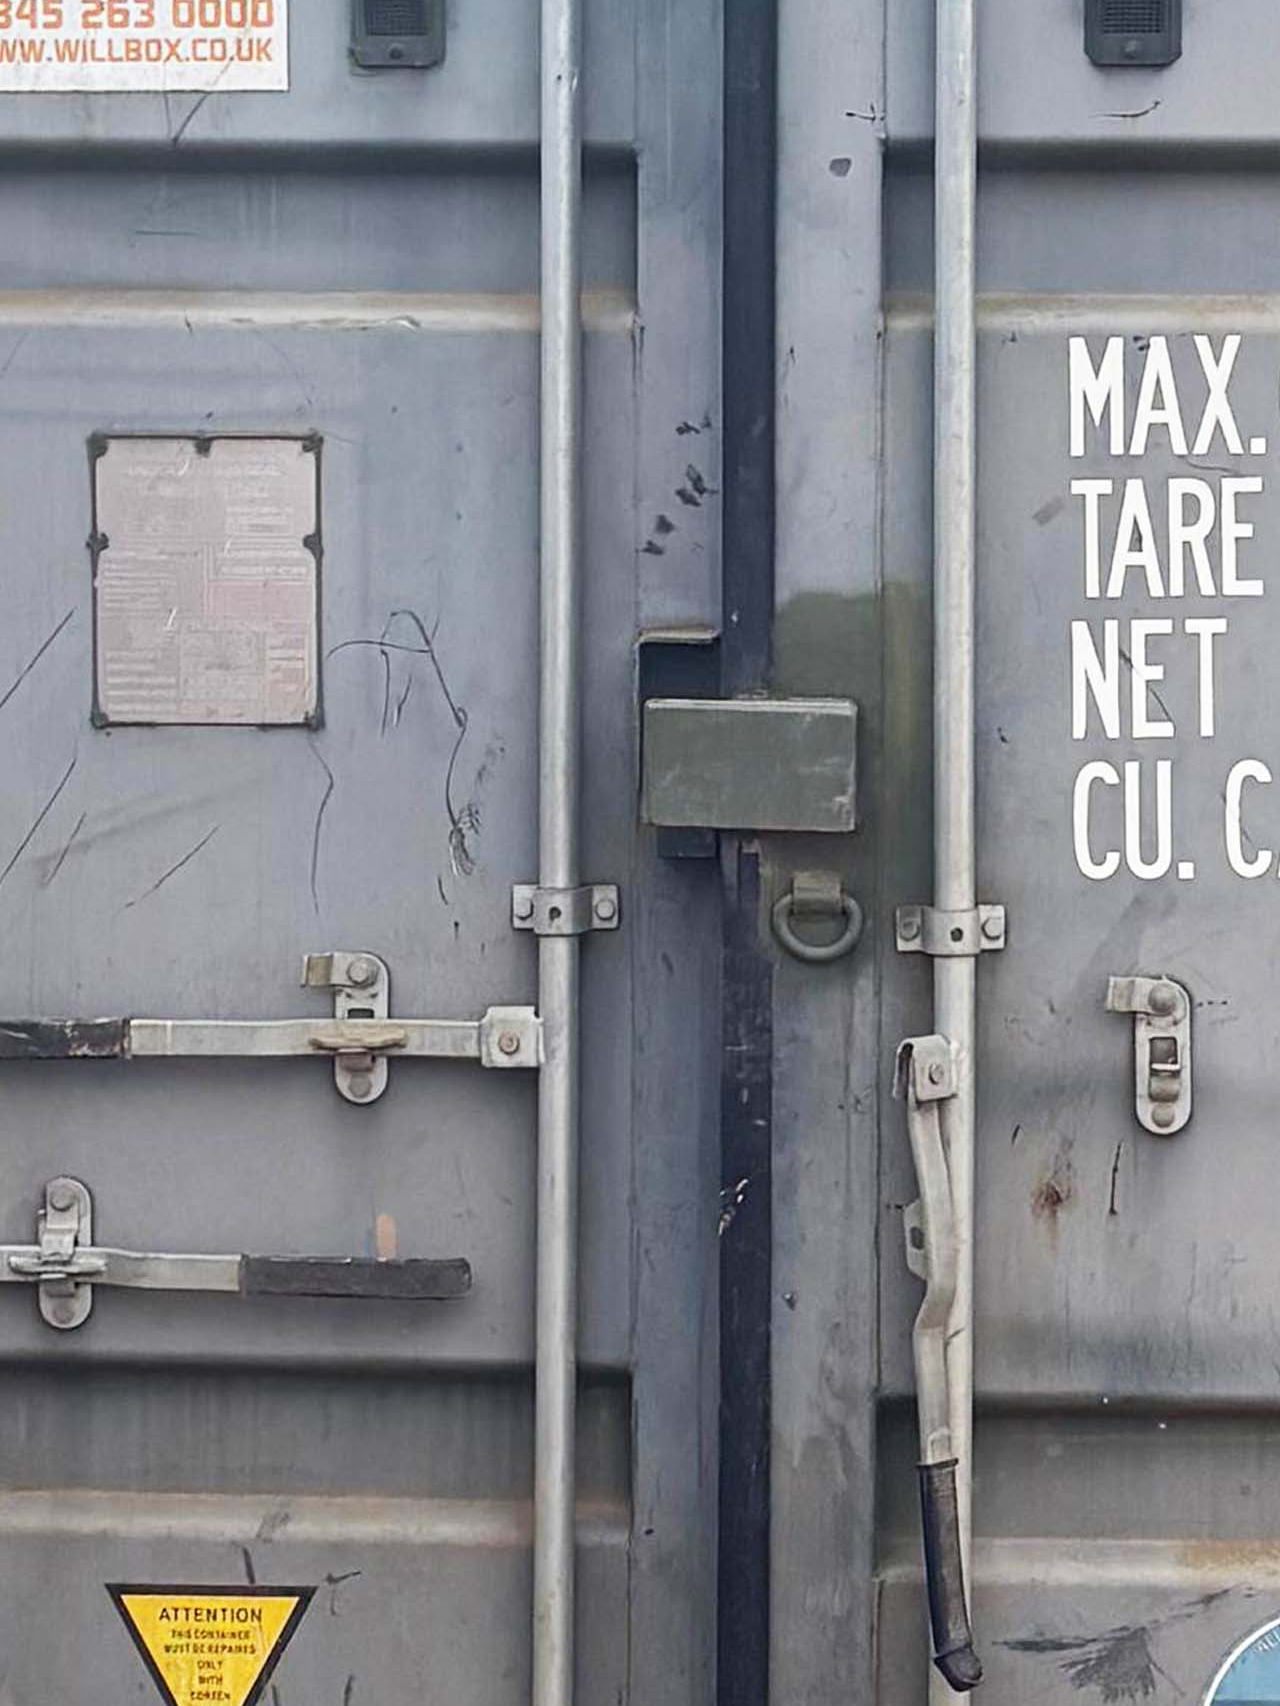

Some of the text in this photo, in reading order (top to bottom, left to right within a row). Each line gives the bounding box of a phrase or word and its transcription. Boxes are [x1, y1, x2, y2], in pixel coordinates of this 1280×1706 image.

[1070, 476, 1265, 600] TARE
[1070, 618, 1227, 740] NET
[1071, 759, 1195, 882] CU.
[159, 1607, 262, 1623] ATTENTION
[197, 1660, 223, 1670] ONLY
[198, 1675, 223, 1685] WITH
